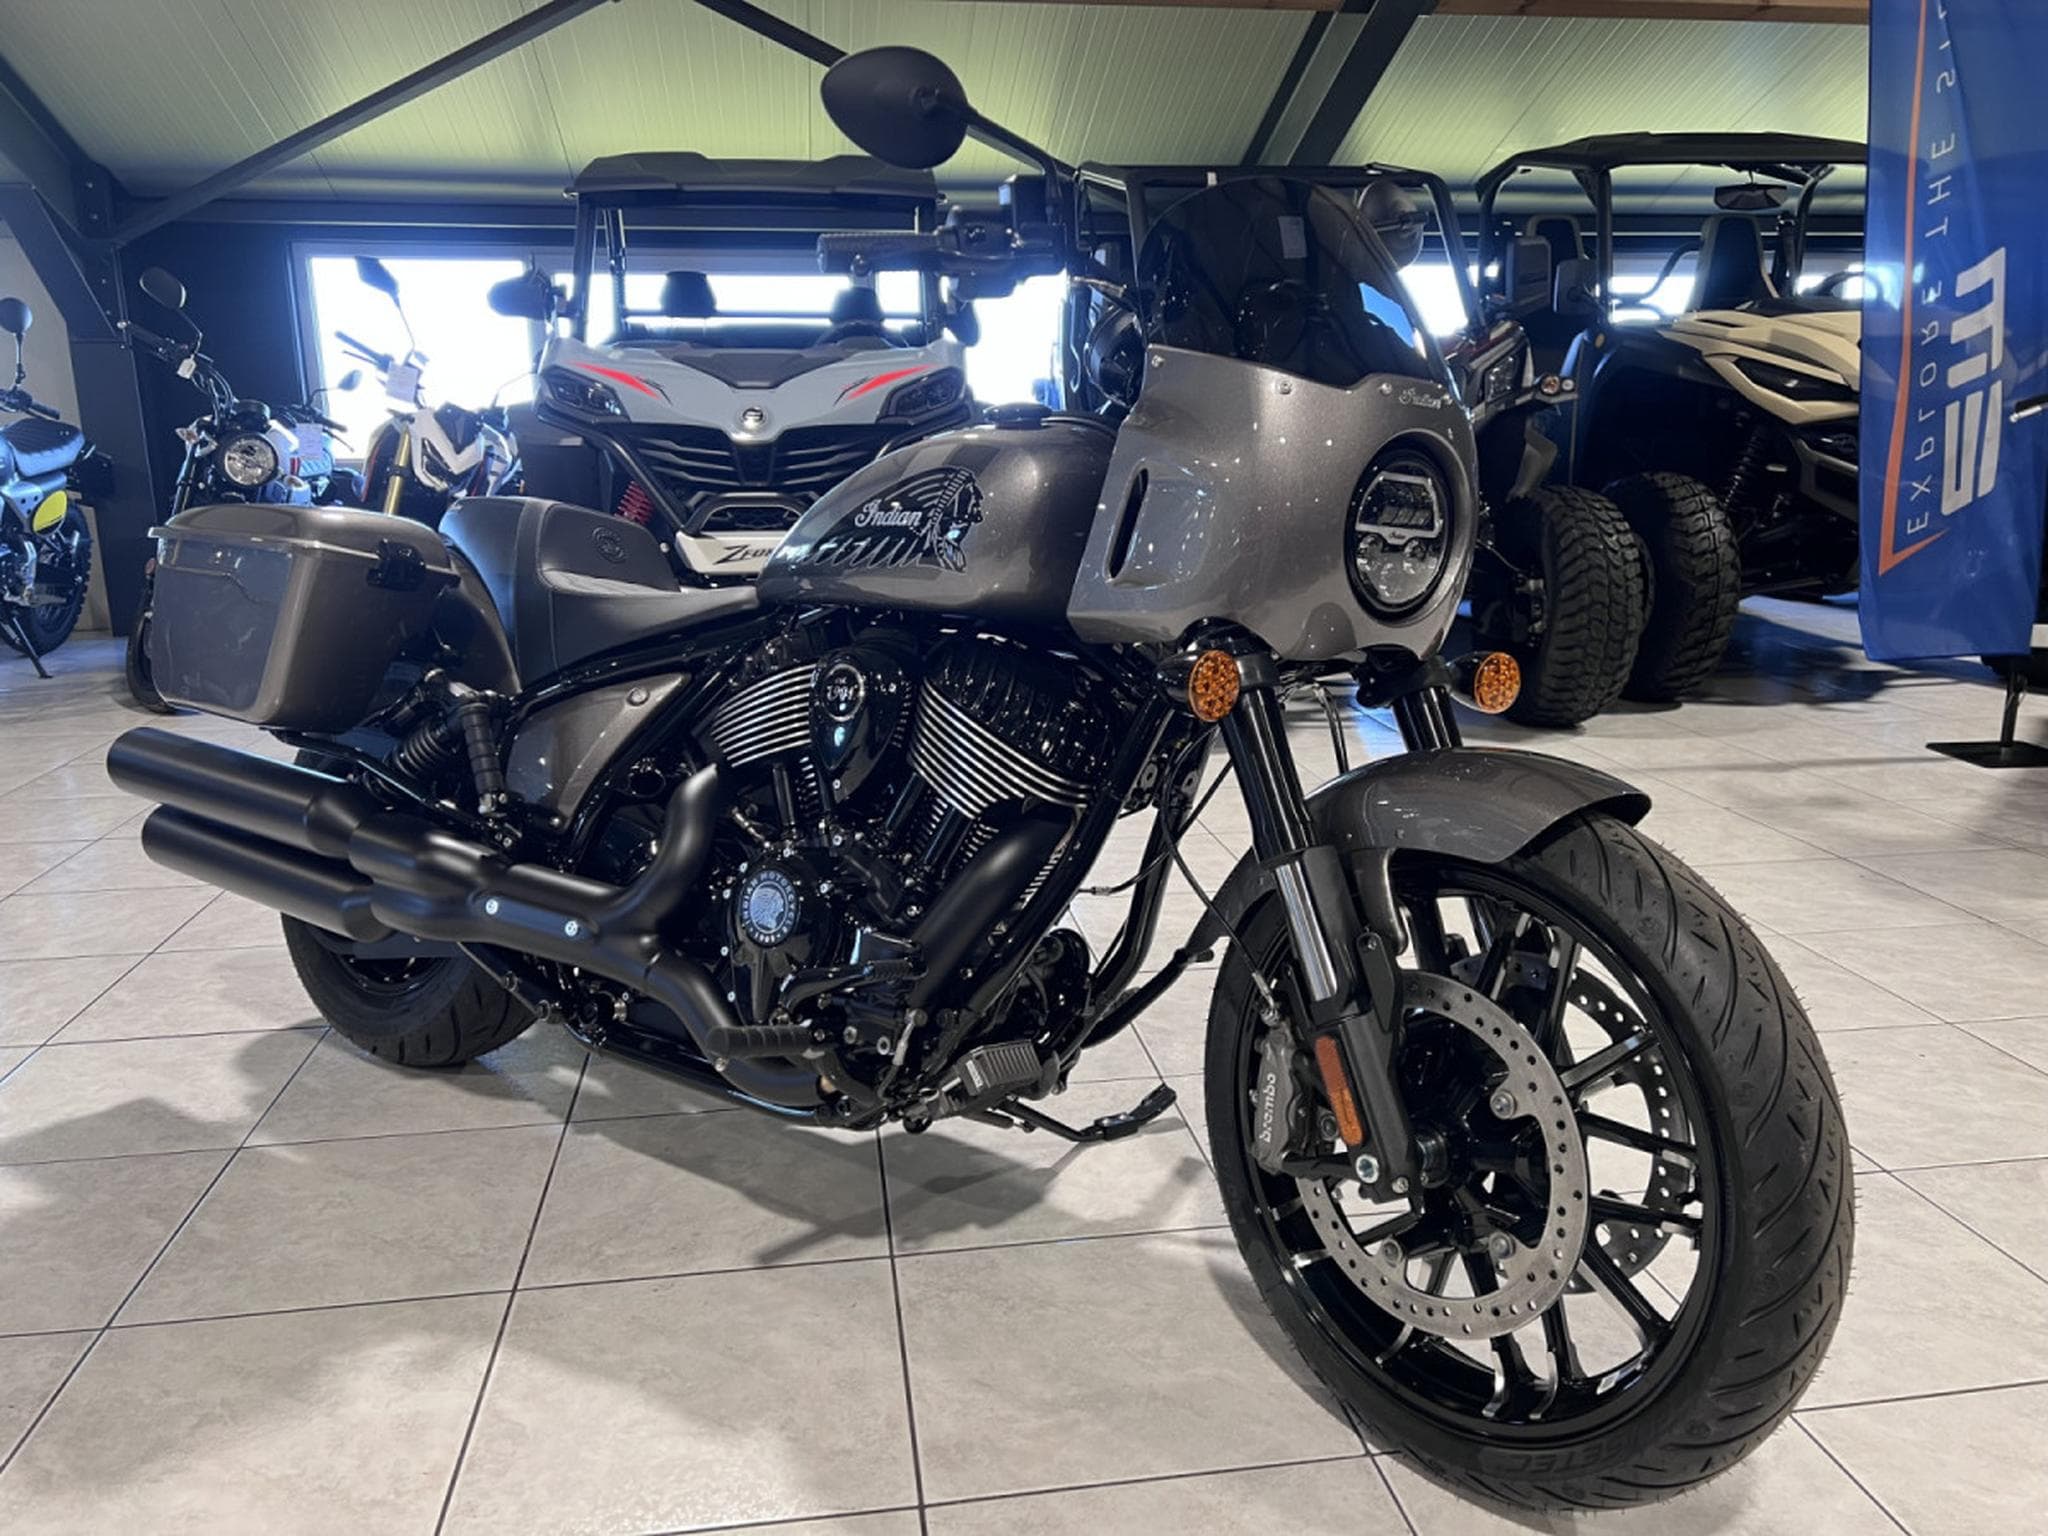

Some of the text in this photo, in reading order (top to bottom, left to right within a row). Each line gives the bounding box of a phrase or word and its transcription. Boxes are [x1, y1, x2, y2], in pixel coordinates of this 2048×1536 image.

[855, 499, 922, 528] Indian
[742, 871, 796, 934] INDIAN MOTORCYCLE
[1259, 1073, 1276, 1143] brembo
